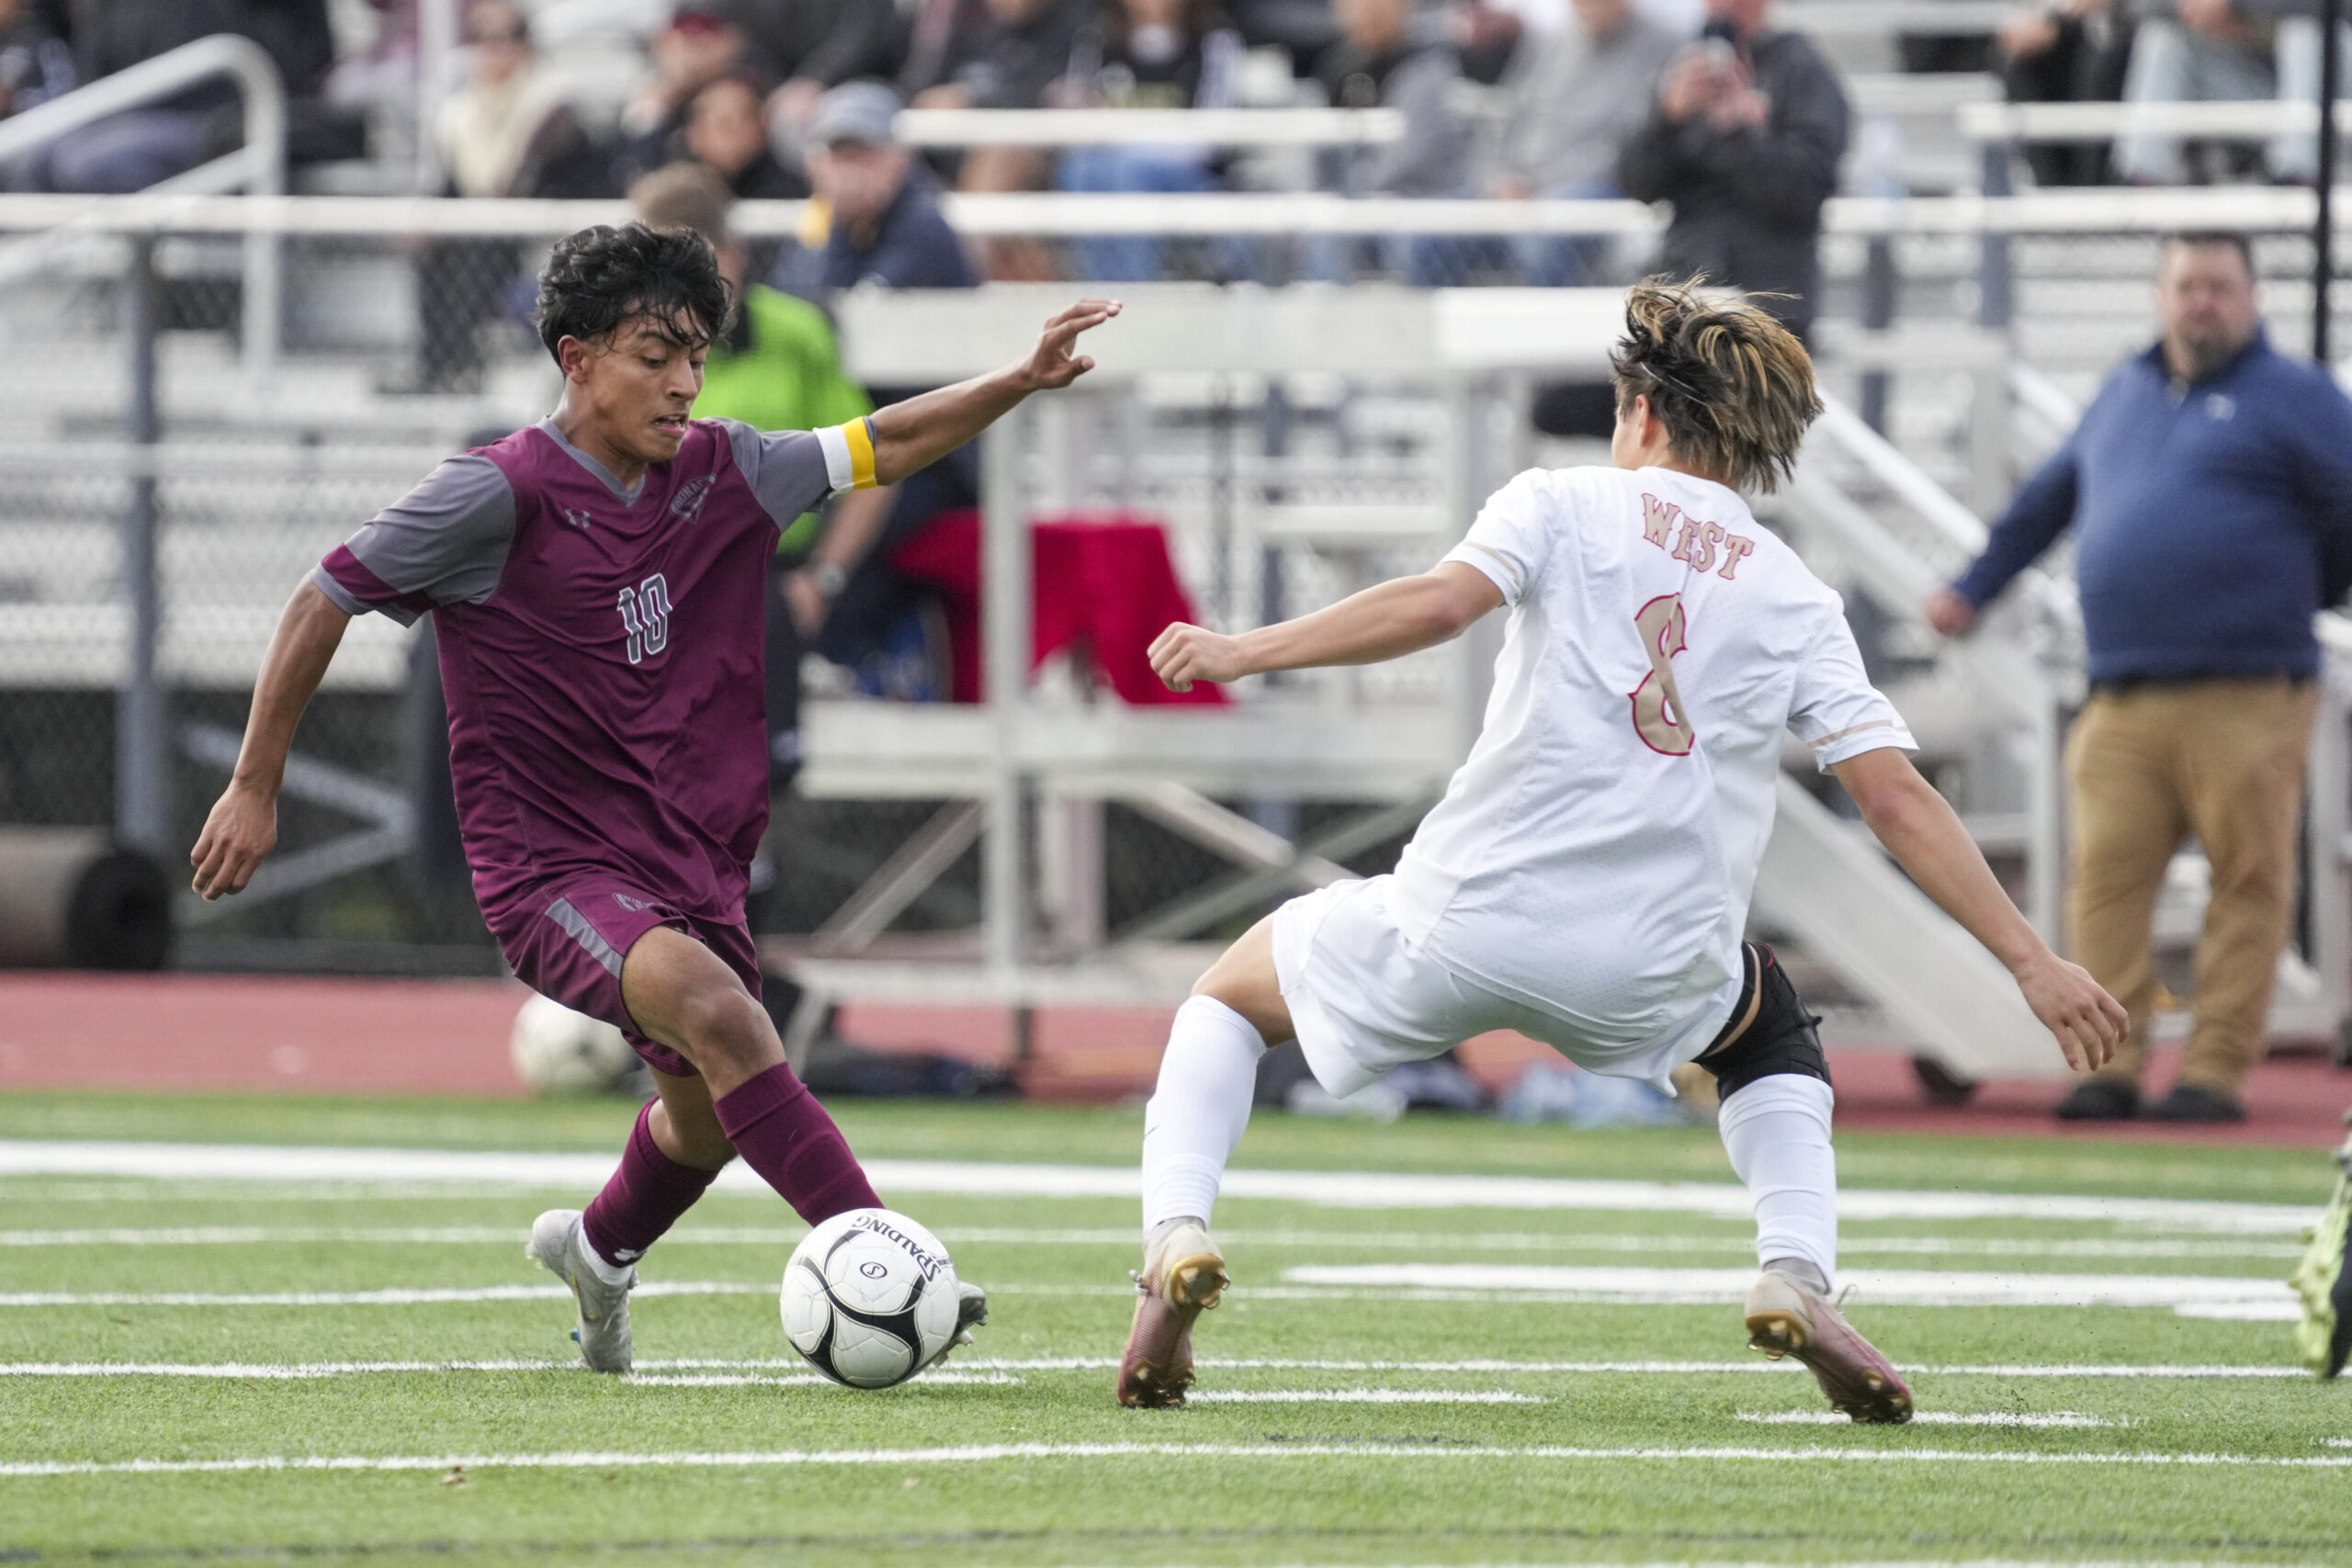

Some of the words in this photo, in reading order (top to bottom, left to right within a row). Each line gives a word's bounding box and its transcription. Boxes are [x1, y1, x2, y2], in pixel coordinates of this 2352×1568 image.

[1640, 491, 1756, 581] WEST
[616, 572, 673, 665] 10
[851, 1215, 942, 1282] SPALDING
